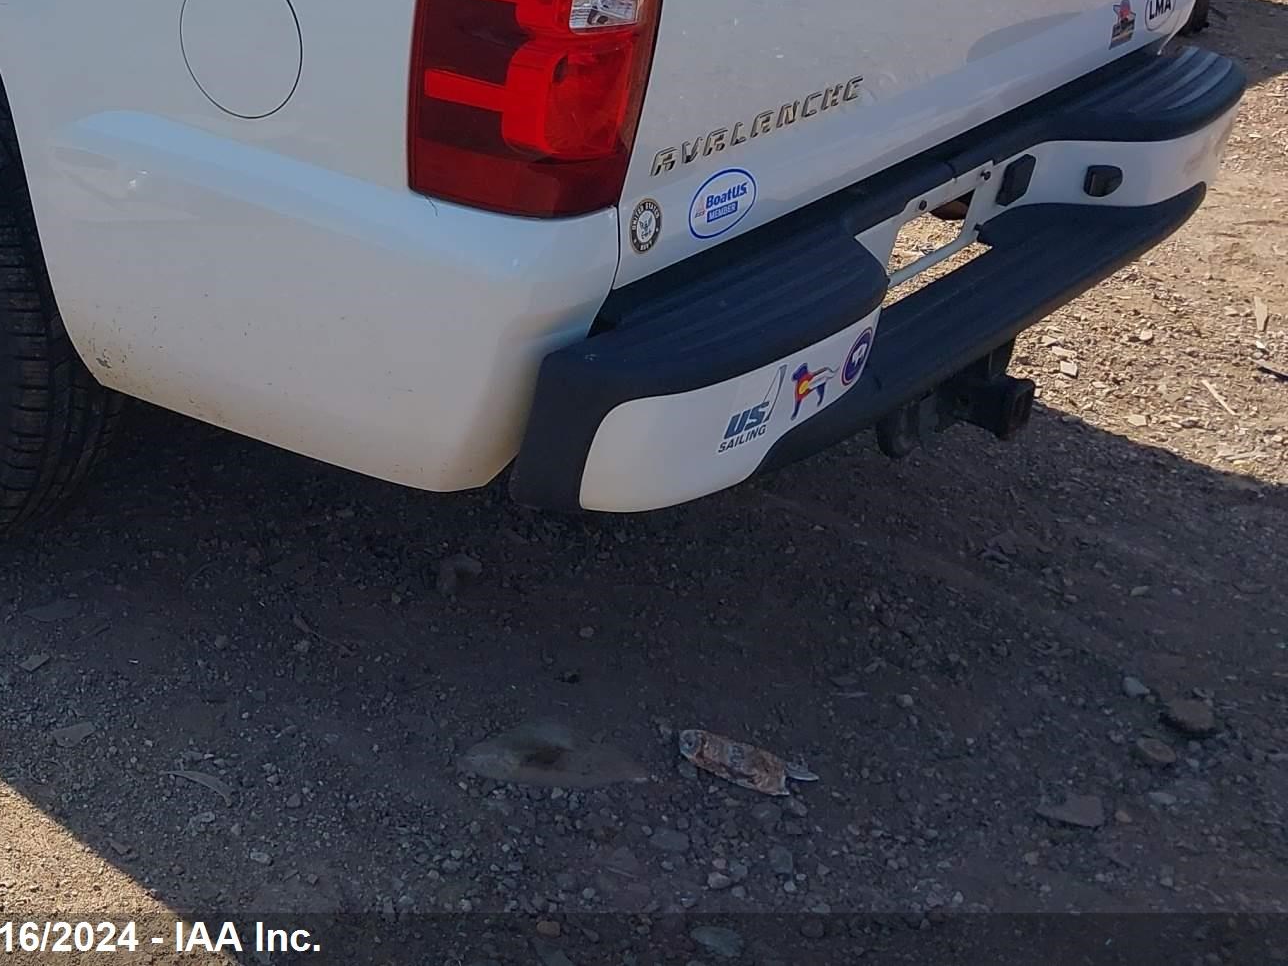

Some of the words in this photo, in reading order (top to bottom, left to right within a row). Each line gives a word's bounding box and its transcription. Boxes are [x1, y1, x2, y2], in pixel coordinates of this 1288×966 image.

[649, 75, 864, 177] AVALANCHE
[645, 202, 660, 219] STATES
[709, 203, 737, 220] MEMBER
[724, 401, 770, 439] US
[718, 424, 767, 453] SAILING
